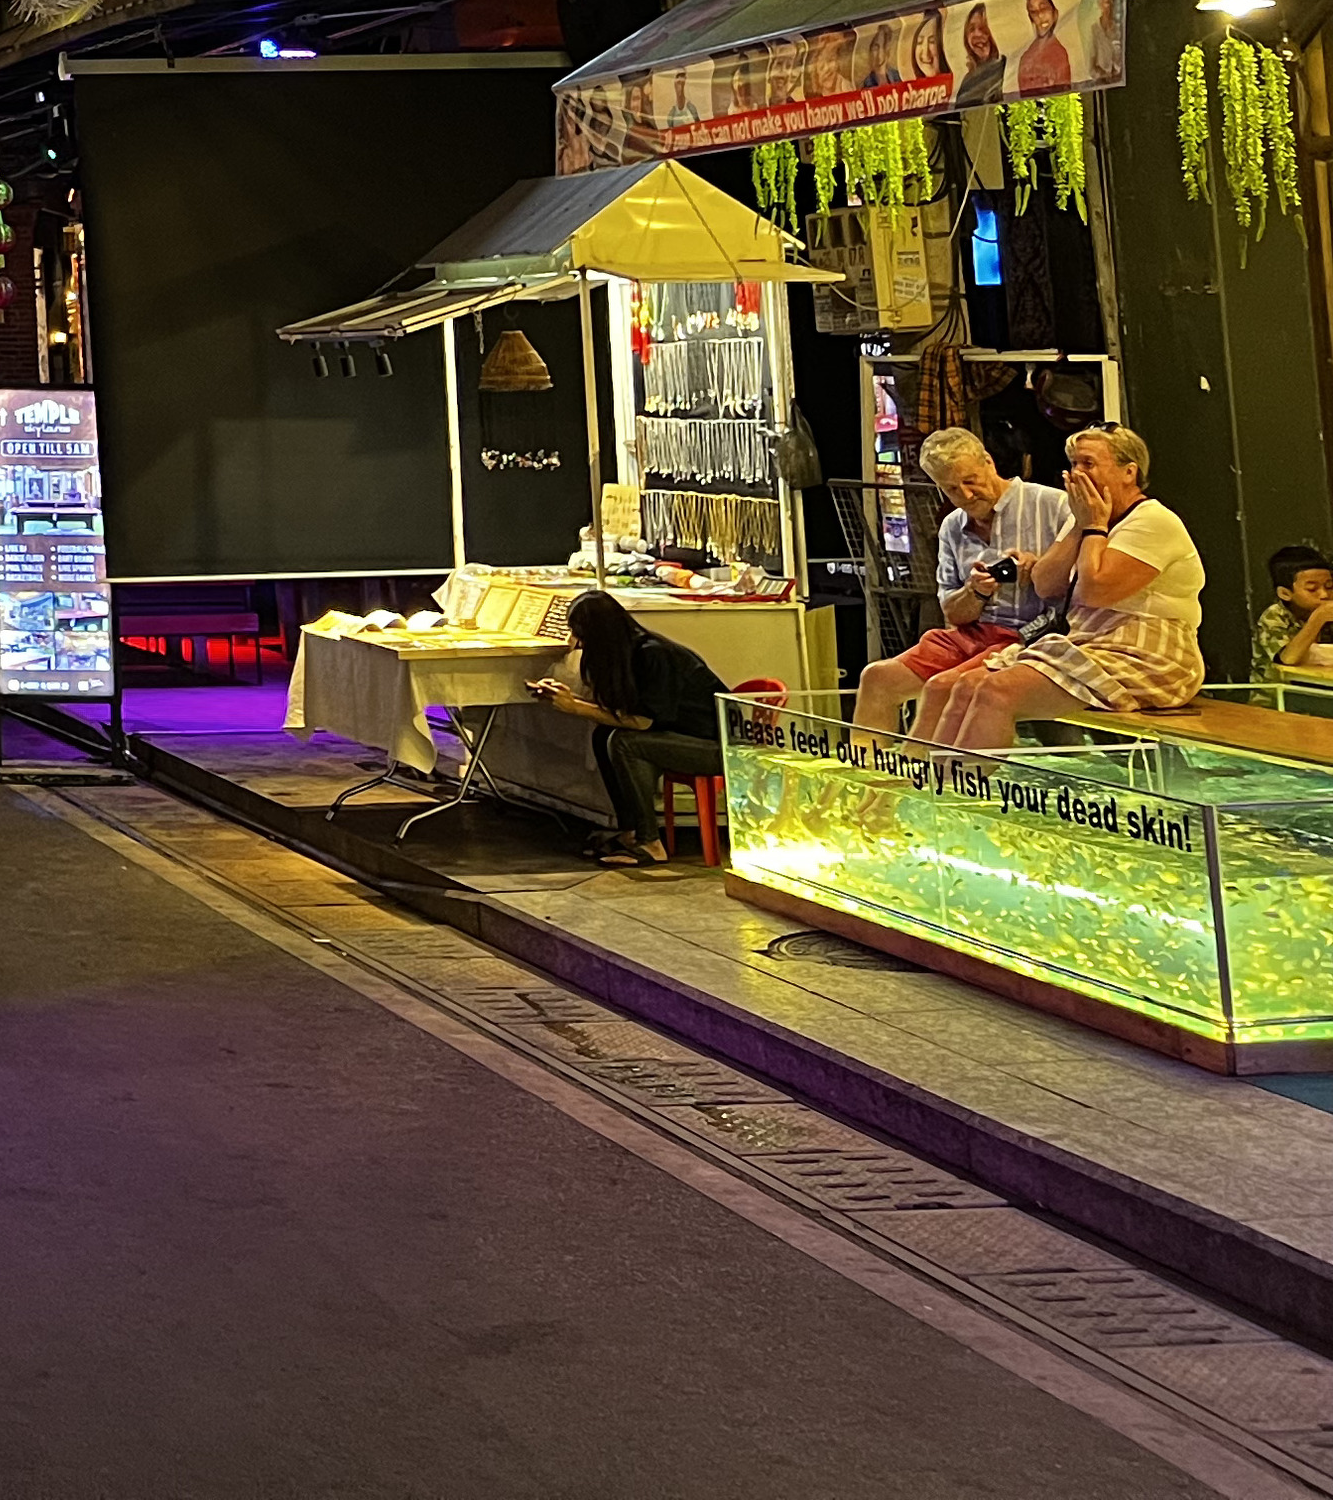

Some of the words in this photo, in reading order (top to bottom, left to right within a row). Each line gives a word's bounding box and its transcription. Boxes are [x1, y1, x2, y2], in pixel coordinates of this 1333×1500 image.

[711, 126, 731, 145] can
[732, 120, 750, 141] not
[752, 114, 782, 137] make
[783, 111, 805, 133] you
[805, 101, 843, 130] happy
[845, 90, 875, 120] we'll
[878, 89, 899, 115] not
[14, 399, 80, 425] TEMPLE
[6, 442, 36, 454] OPEN
[39, 443, 63, 454] TILL
[728, 707, 785, 748] Please
[790, 722, 831, 759] feed
[837, 740, 866, 769] our
[872, 740, 944, 796] hungry
[951, 760, 991, 801] fish
[997, 779, 1048, 815] your
[1057, 786, 1119, 833] dead
[1127, 805, 1193, 853] skin!
